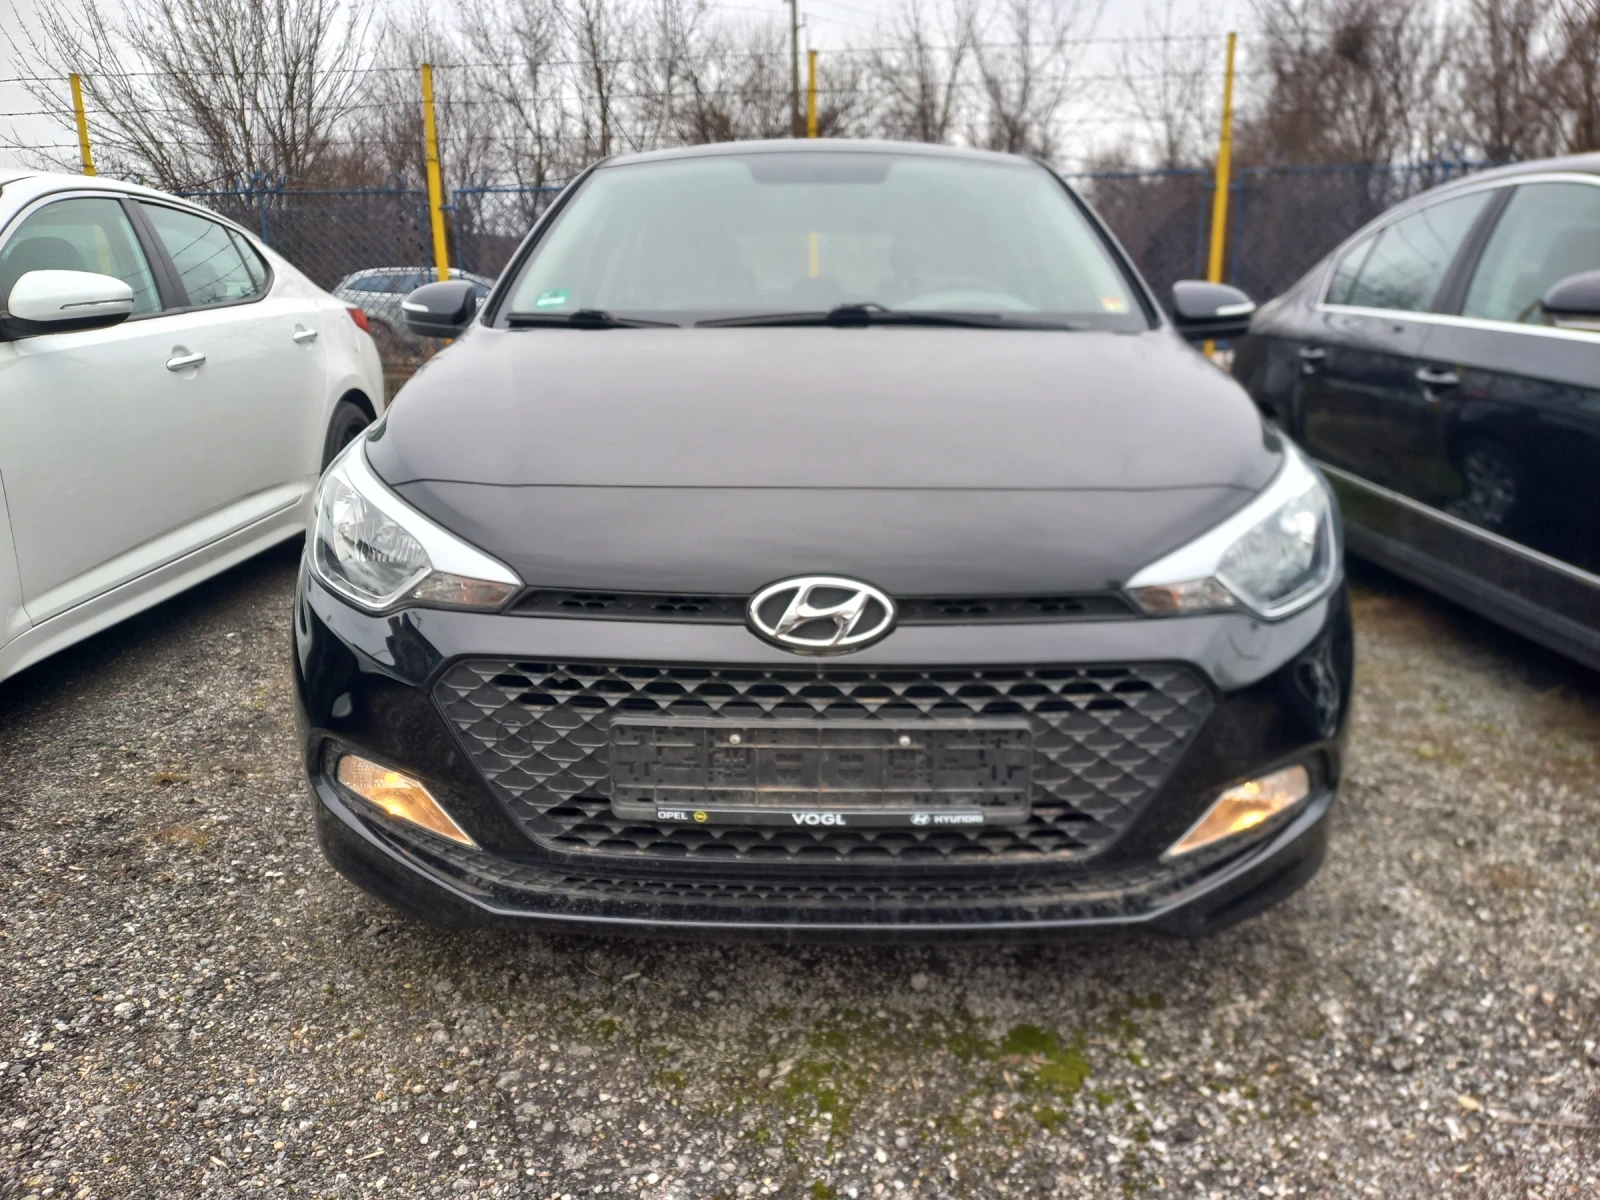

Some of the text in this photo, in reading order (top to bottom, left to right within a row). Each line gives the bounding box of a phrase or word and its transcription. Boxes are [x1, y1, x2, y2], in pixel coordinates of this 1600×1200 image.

[657, 811, 688, 820] OPEL
[791, 813, 847, 825] VOGL
[933, 814, 984, 824] HYUNDAI
